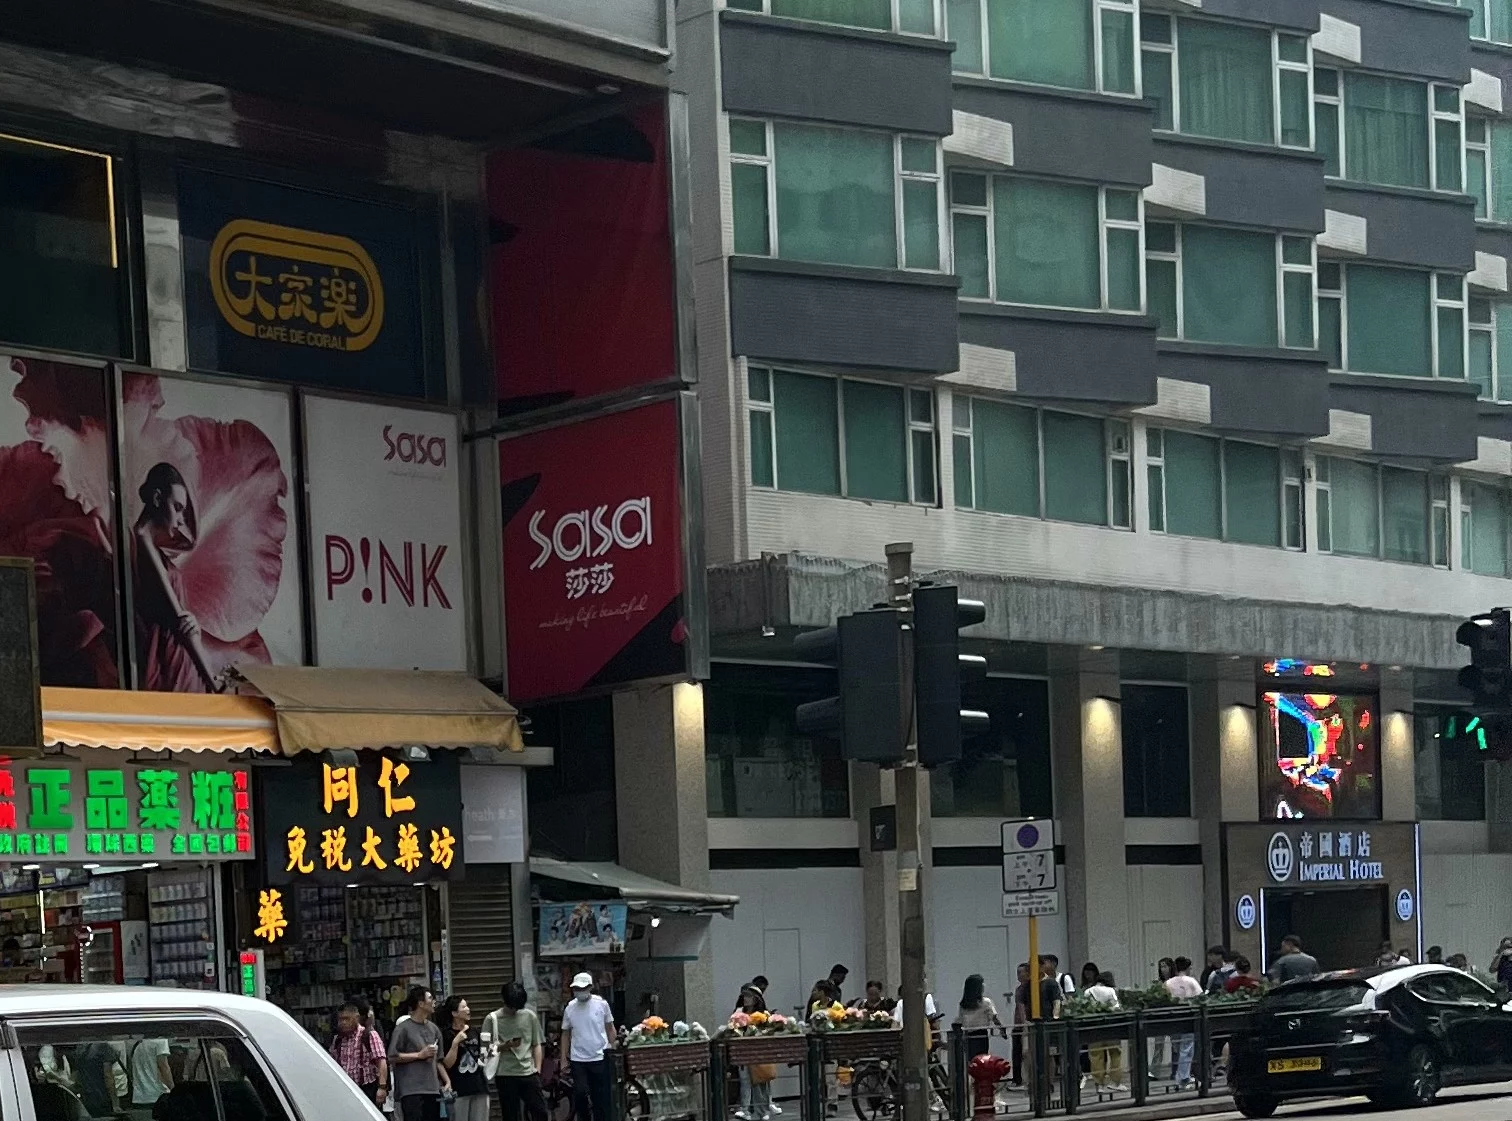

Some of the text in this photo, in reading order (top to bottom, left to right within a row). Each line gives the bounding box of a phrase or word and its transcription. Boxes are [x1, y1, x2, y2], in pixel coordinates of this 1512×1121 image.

[289, 329, 306, 345] DE
[307, 332, 346, 350] CORAL
[325, 534, 452, 610] P!NK
[565, 562, 615, 599] 莎莎
[576, 606, 598, 629] life
[599, 594, 649, 621] beautiful
[322, 756, 416, 818] 同仁
[1036, 854, 1045, 867] 7
[1036, 873, 1045, 887] 7
